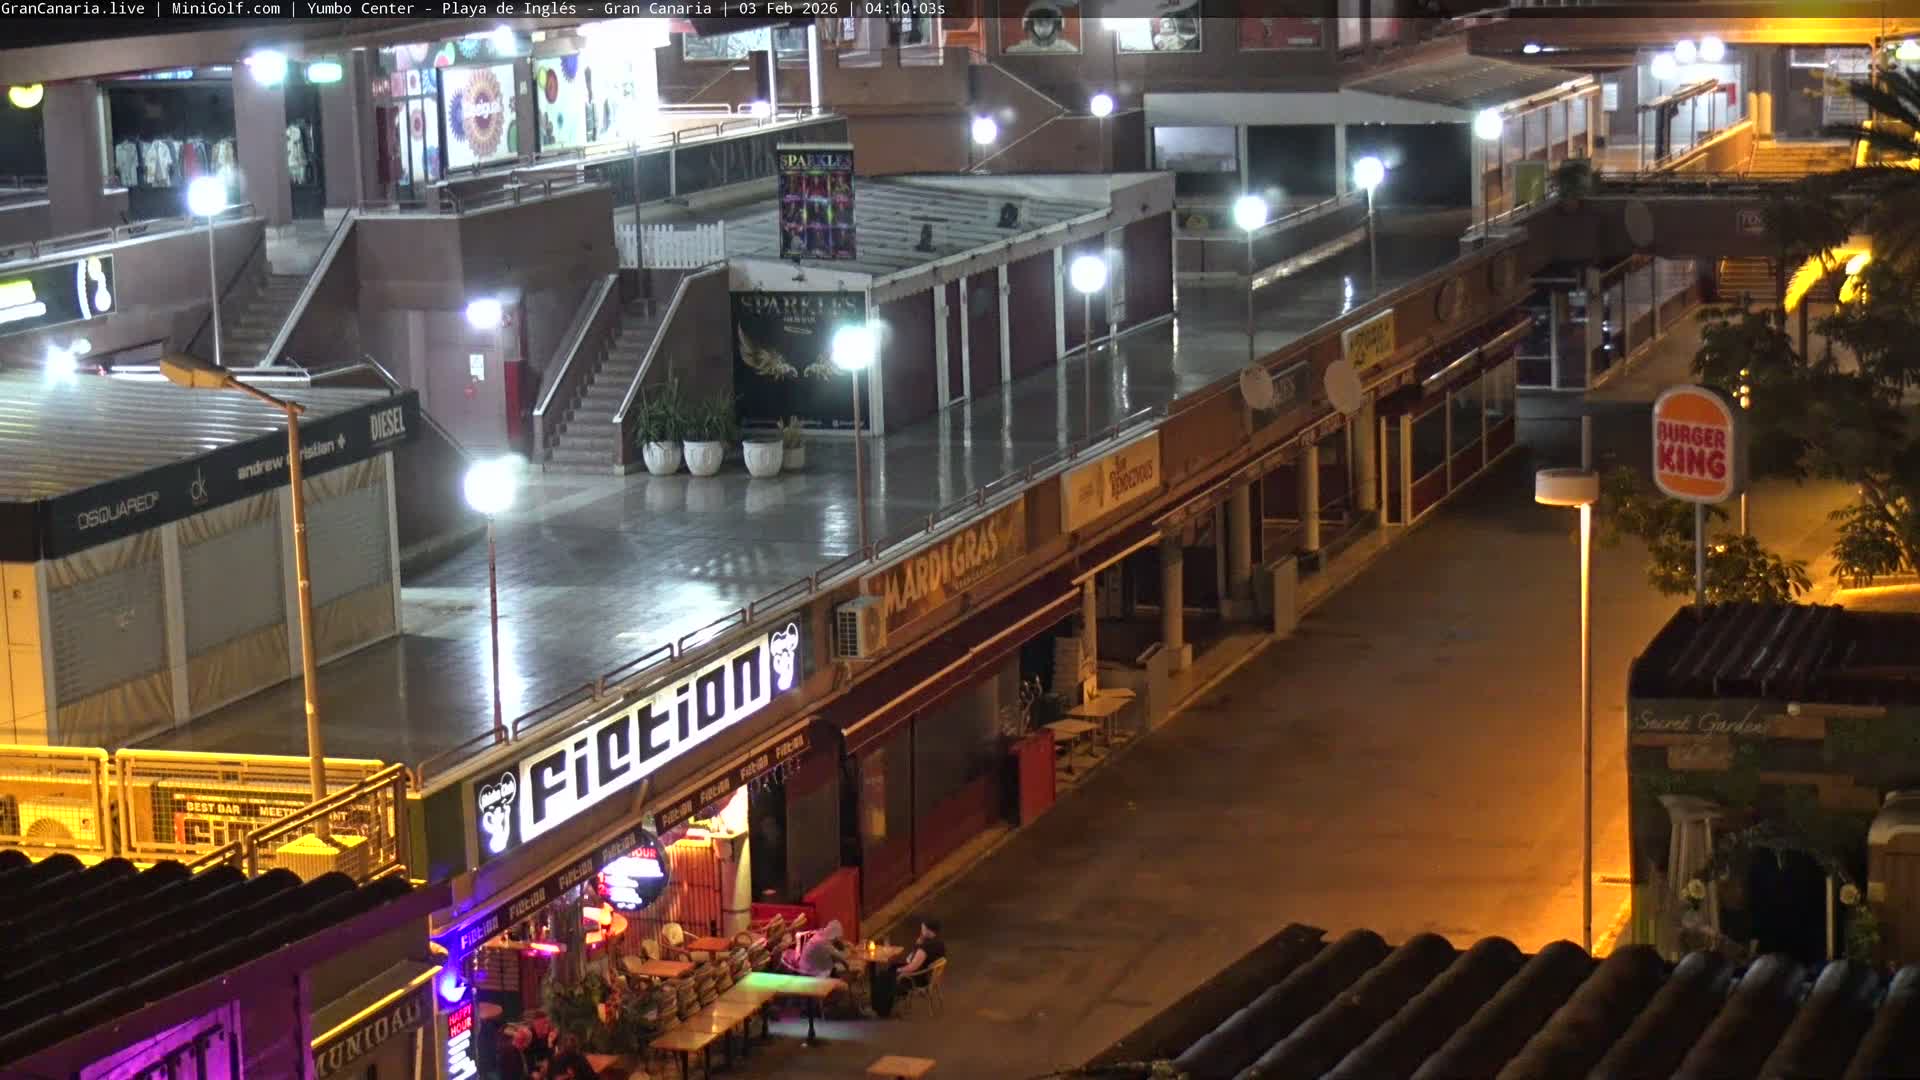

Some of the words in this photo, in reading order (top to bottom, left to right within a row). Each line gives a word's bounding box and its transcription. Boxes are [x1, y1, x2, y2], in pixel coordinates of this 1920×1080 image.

[369, 405, 406, 441] DIESEL
[1656, 420, 1726, 450] BURGER
[236, 453, 284, 481] andrew
[1657, 443, 1727, 481] KING
[884, 543, 948, 615] MARDI
[951, 518, 999, 578] GRAS
[186, 801, 215, 814] BEST
[217, 804, 241, 815] BAR
[448, 1003, 472, 1027] HAPPY
[449, 1016, 472, 1038] HOUR
